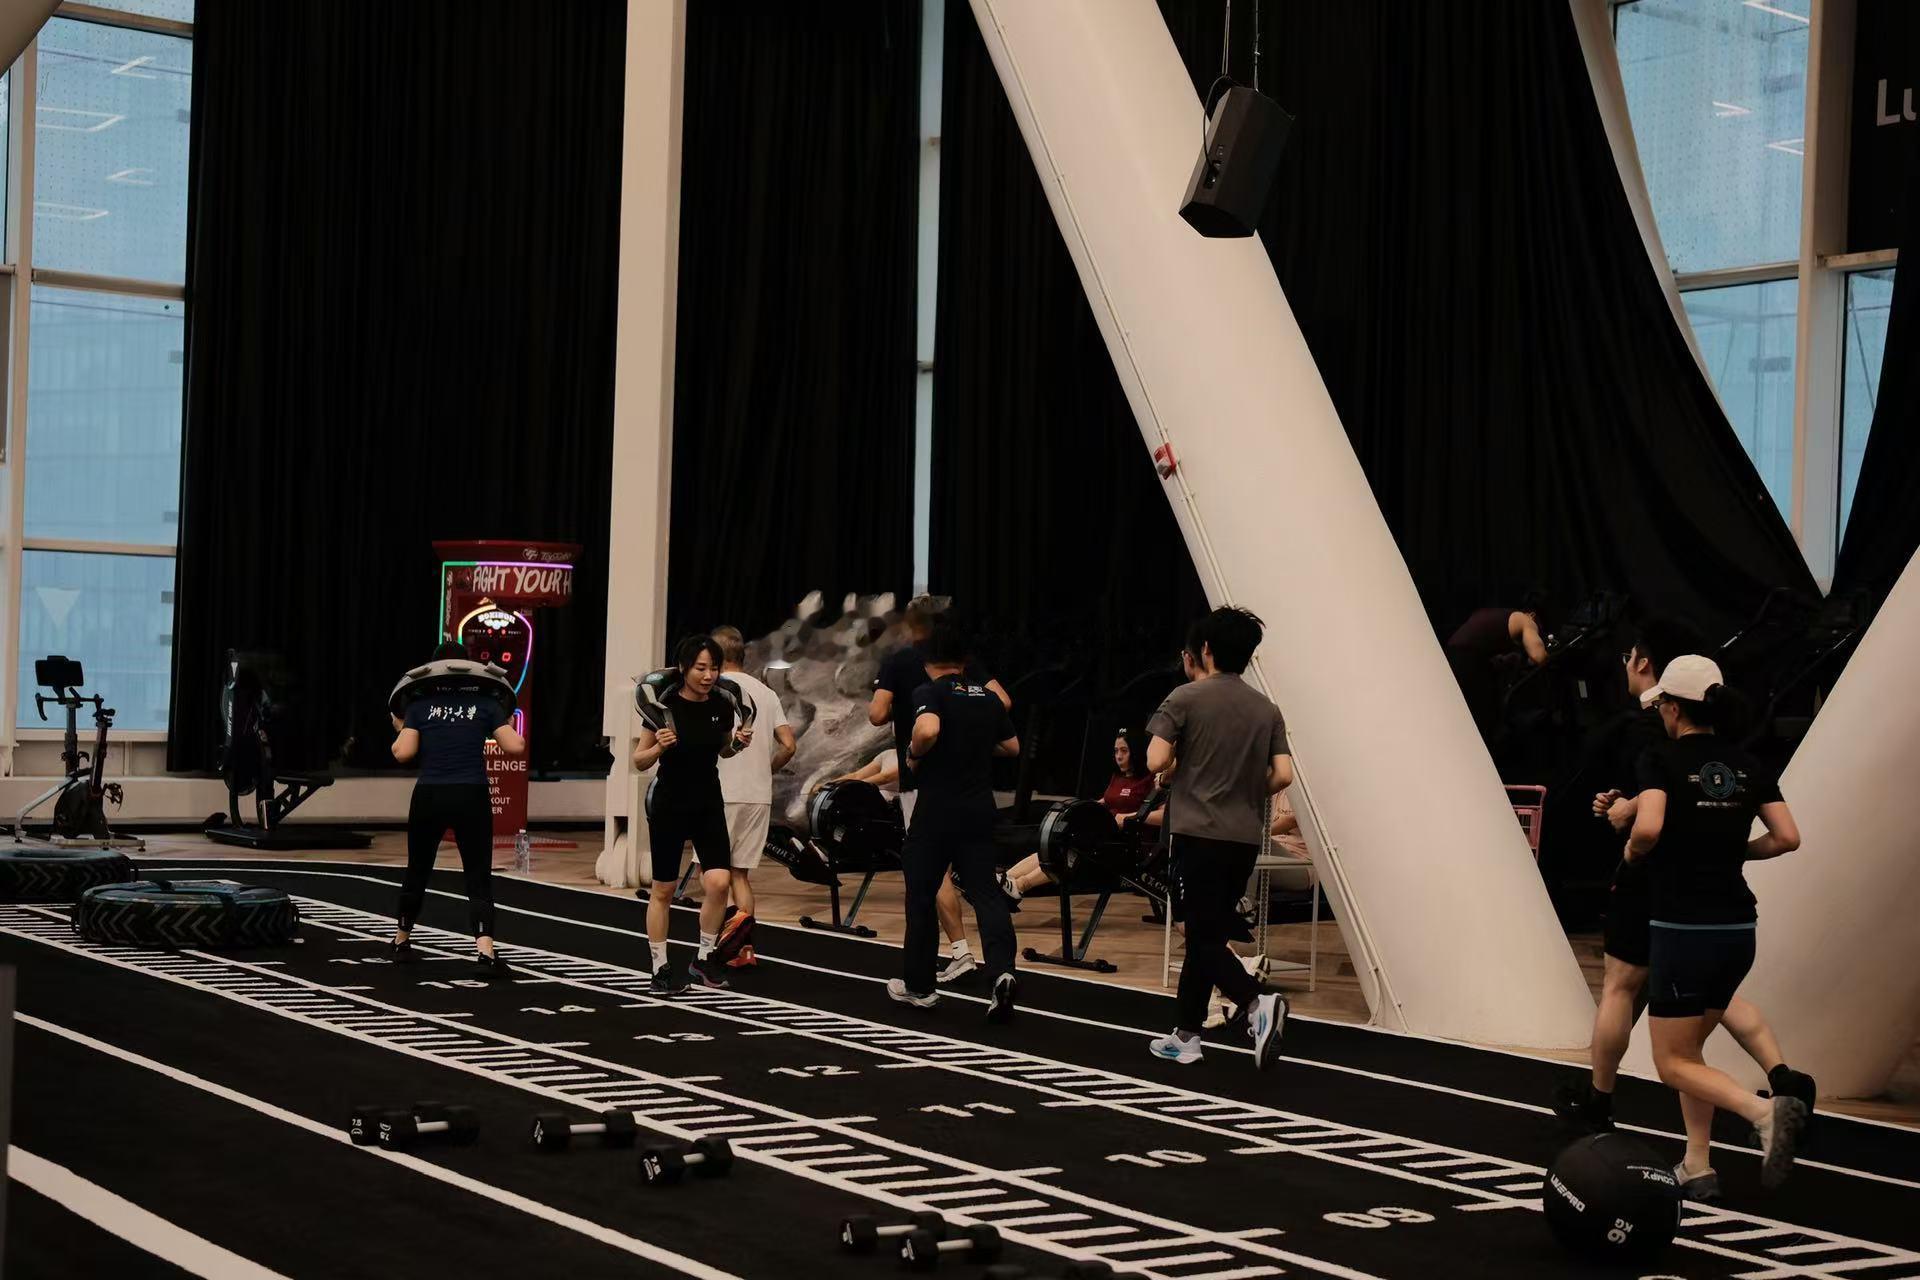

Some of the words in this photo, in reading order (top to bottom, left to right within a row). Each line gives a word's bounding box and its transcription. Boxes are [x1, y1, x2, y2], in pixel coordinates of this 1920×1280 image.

[513, 566, 562, 594] YOUR
[563, 569, 573, 595] H
[486, 760, 527, 771] LENGE
[488, 777, 499, 785] ST
[488, 787, 501, 795] UR
[491, 806, 503, 814] ER
[416, 979, 490, 989] 15
[520, 1003, 597, 1016] 14
[632, 1031, 715, 1044] 13
[767, 1064, 861, 1078] 12
[918, 1100, 1016, 1119] 11
[1104, 1148, 1207, 1167] 10
[1322, 1205, 1437, 1229] 09
[1614, 1217, 1634, 1233] KG
